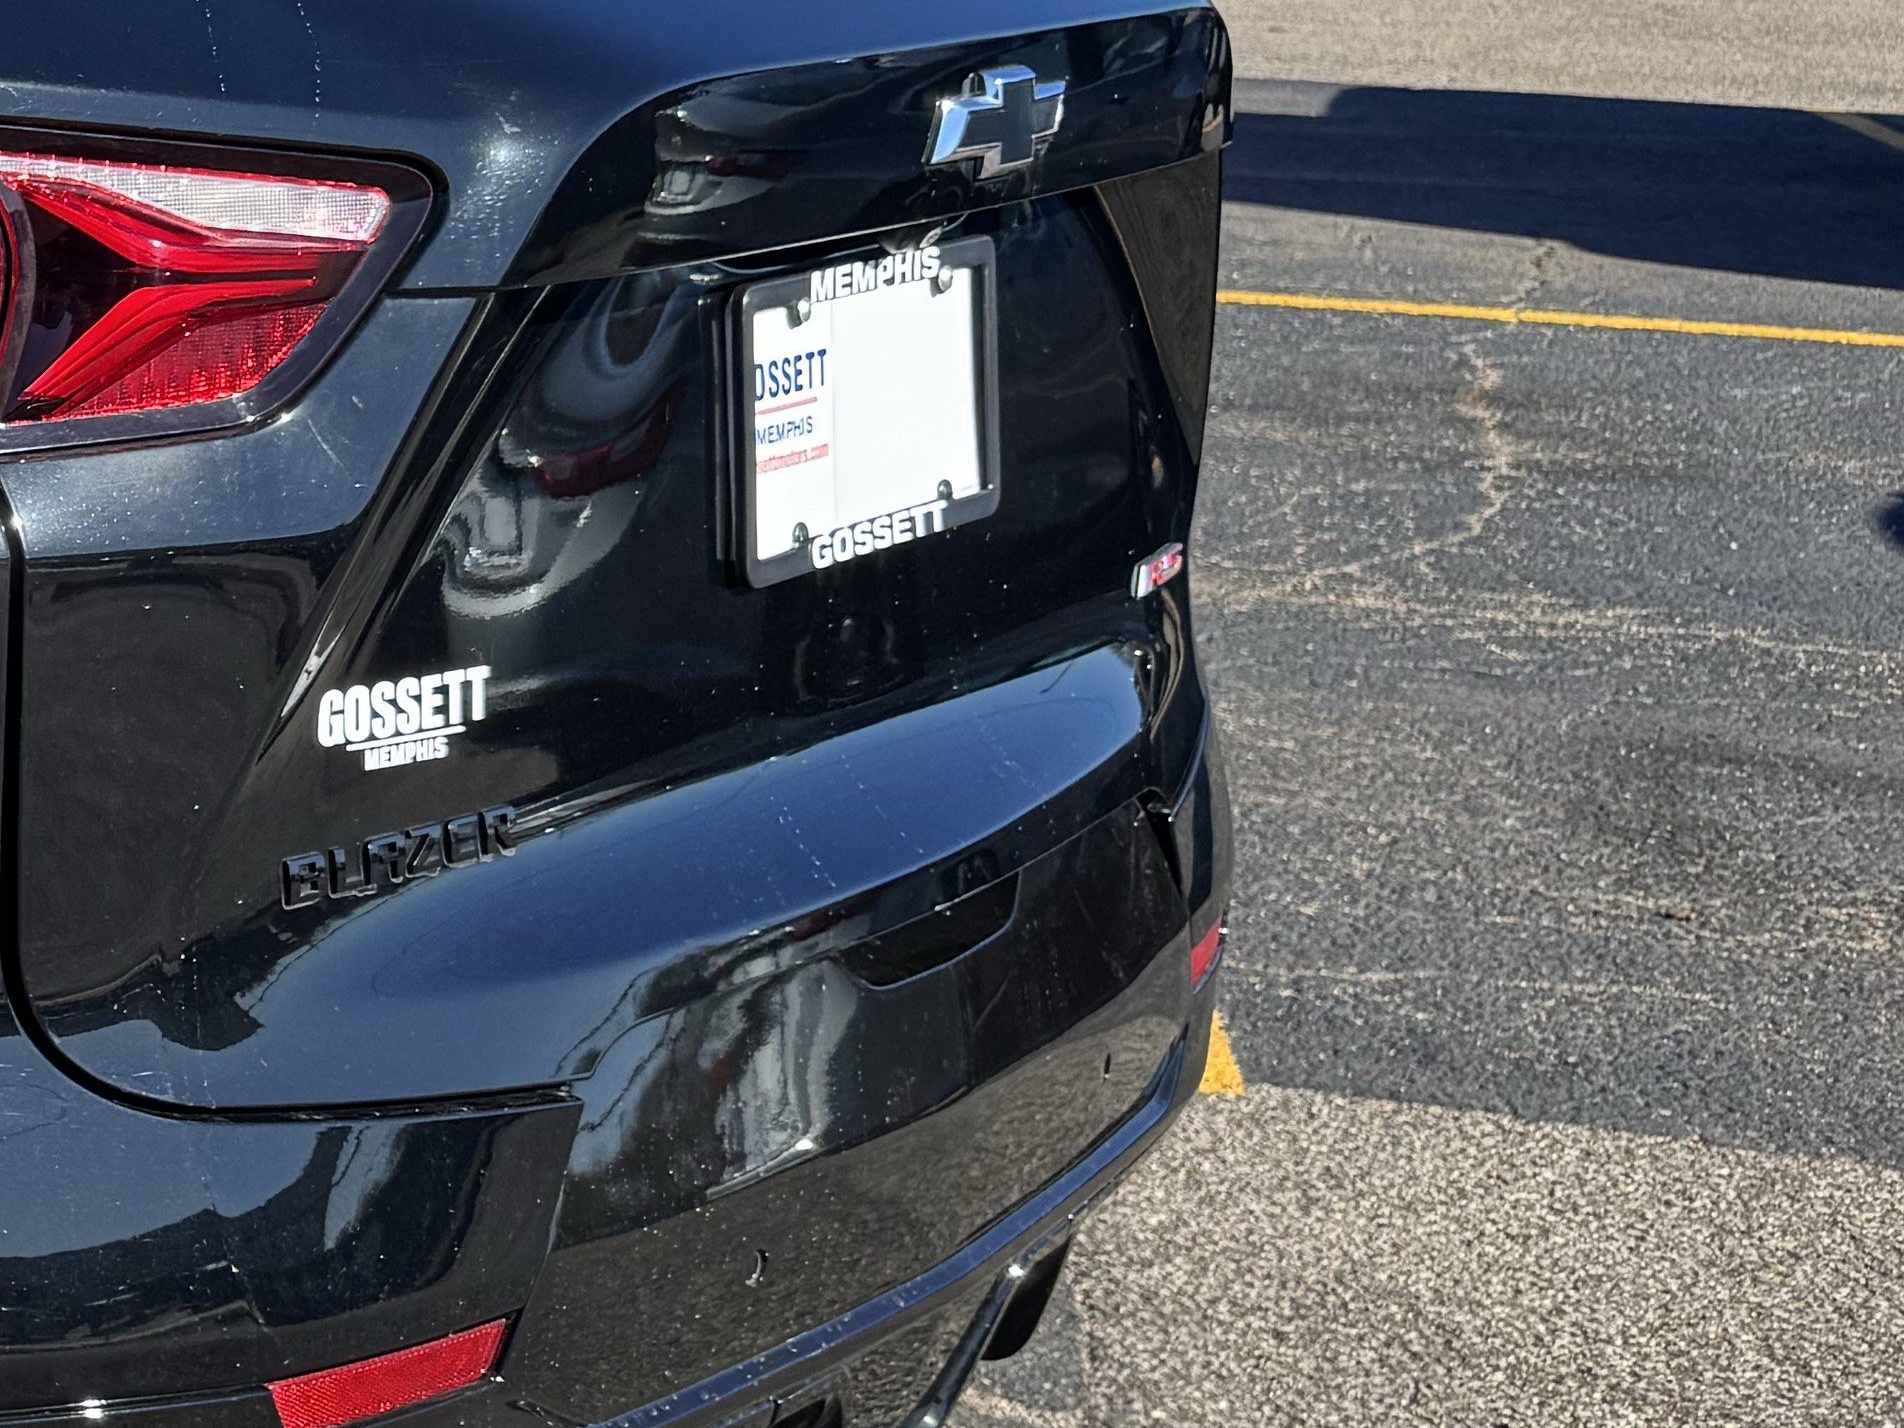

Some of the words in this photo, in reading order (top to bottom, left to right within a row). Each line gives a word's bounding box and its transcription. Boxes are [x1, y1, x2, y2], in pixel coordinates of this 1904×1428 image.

[810, 245, 941, 303] MEMPHIS
[755, 415, 814, 445] MEMPHIS
[811, 499, 949, 570] GOSSETT
[317, 665, 492, 748] GOSSETT
[364, 735, 450, 772] MEMPHIS
[281, 804, 517, 911] BLAZER
